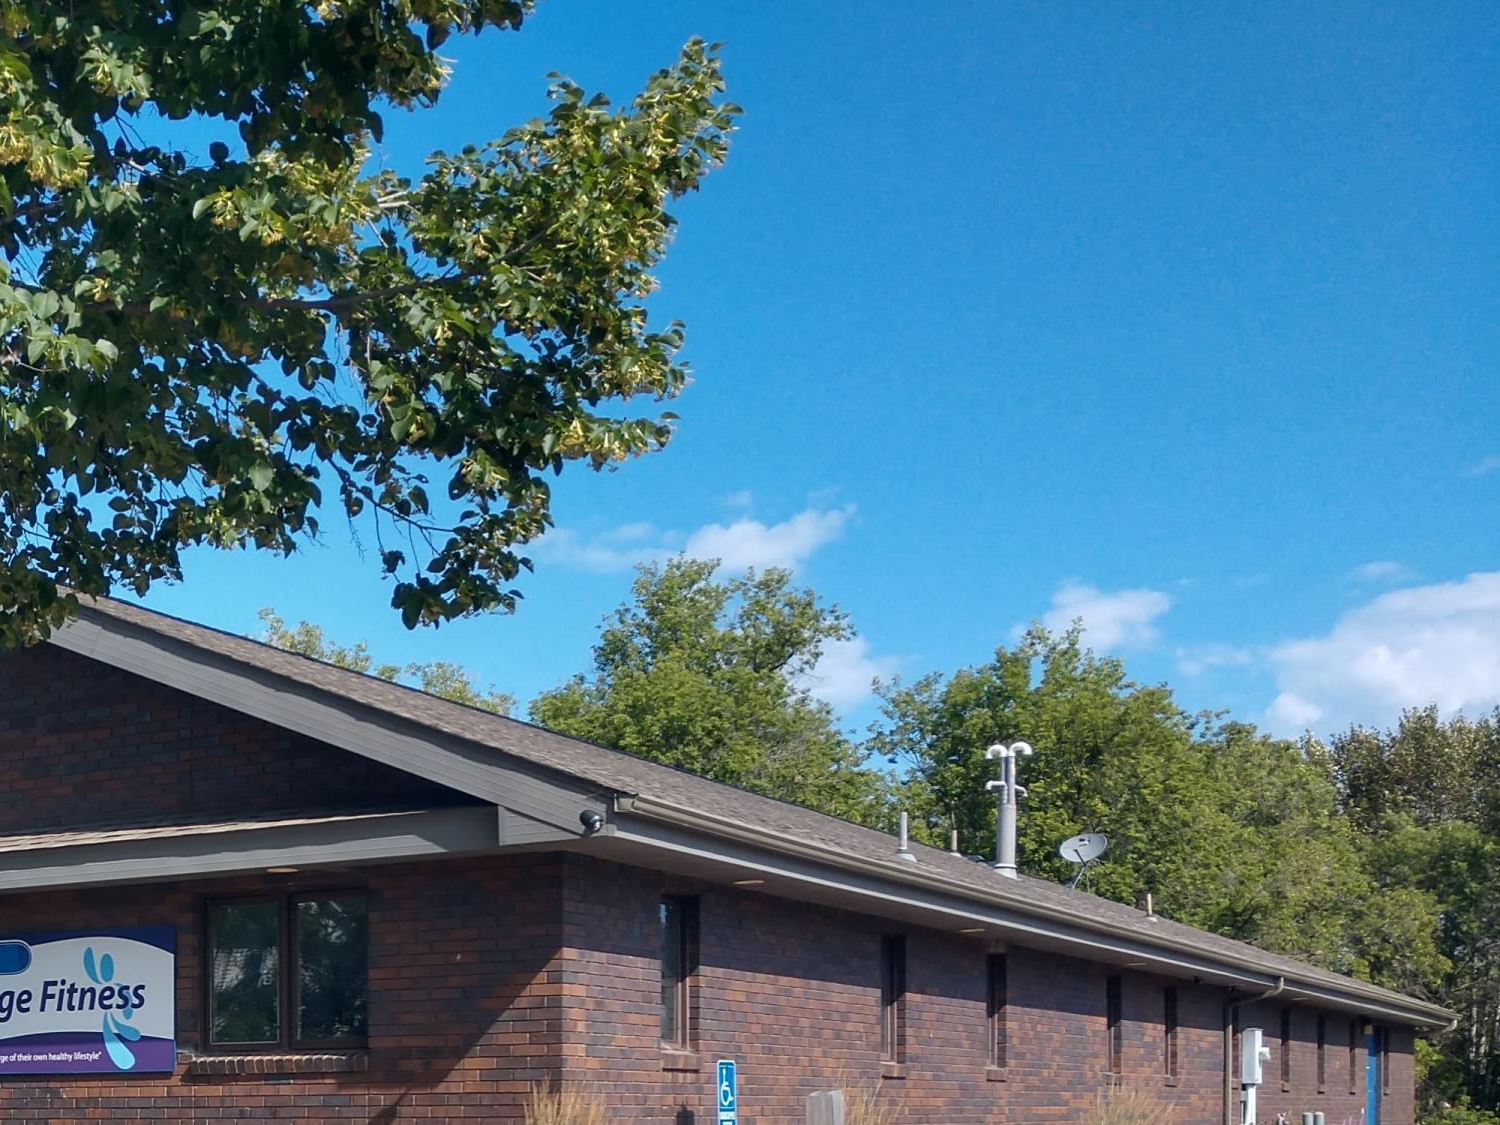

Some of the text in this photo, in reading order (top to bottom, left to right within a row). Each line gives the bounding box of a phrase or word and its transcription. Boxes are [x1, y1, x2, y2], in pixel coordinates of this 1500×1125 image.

[39, 979, 146, 1012] Fitness
[10, 1052, 17, 1062] of
[17, 1053, 32, 1062] their
[32, 1054, 48, 1062] own
[48, 1052, 73, 1063] healthy
